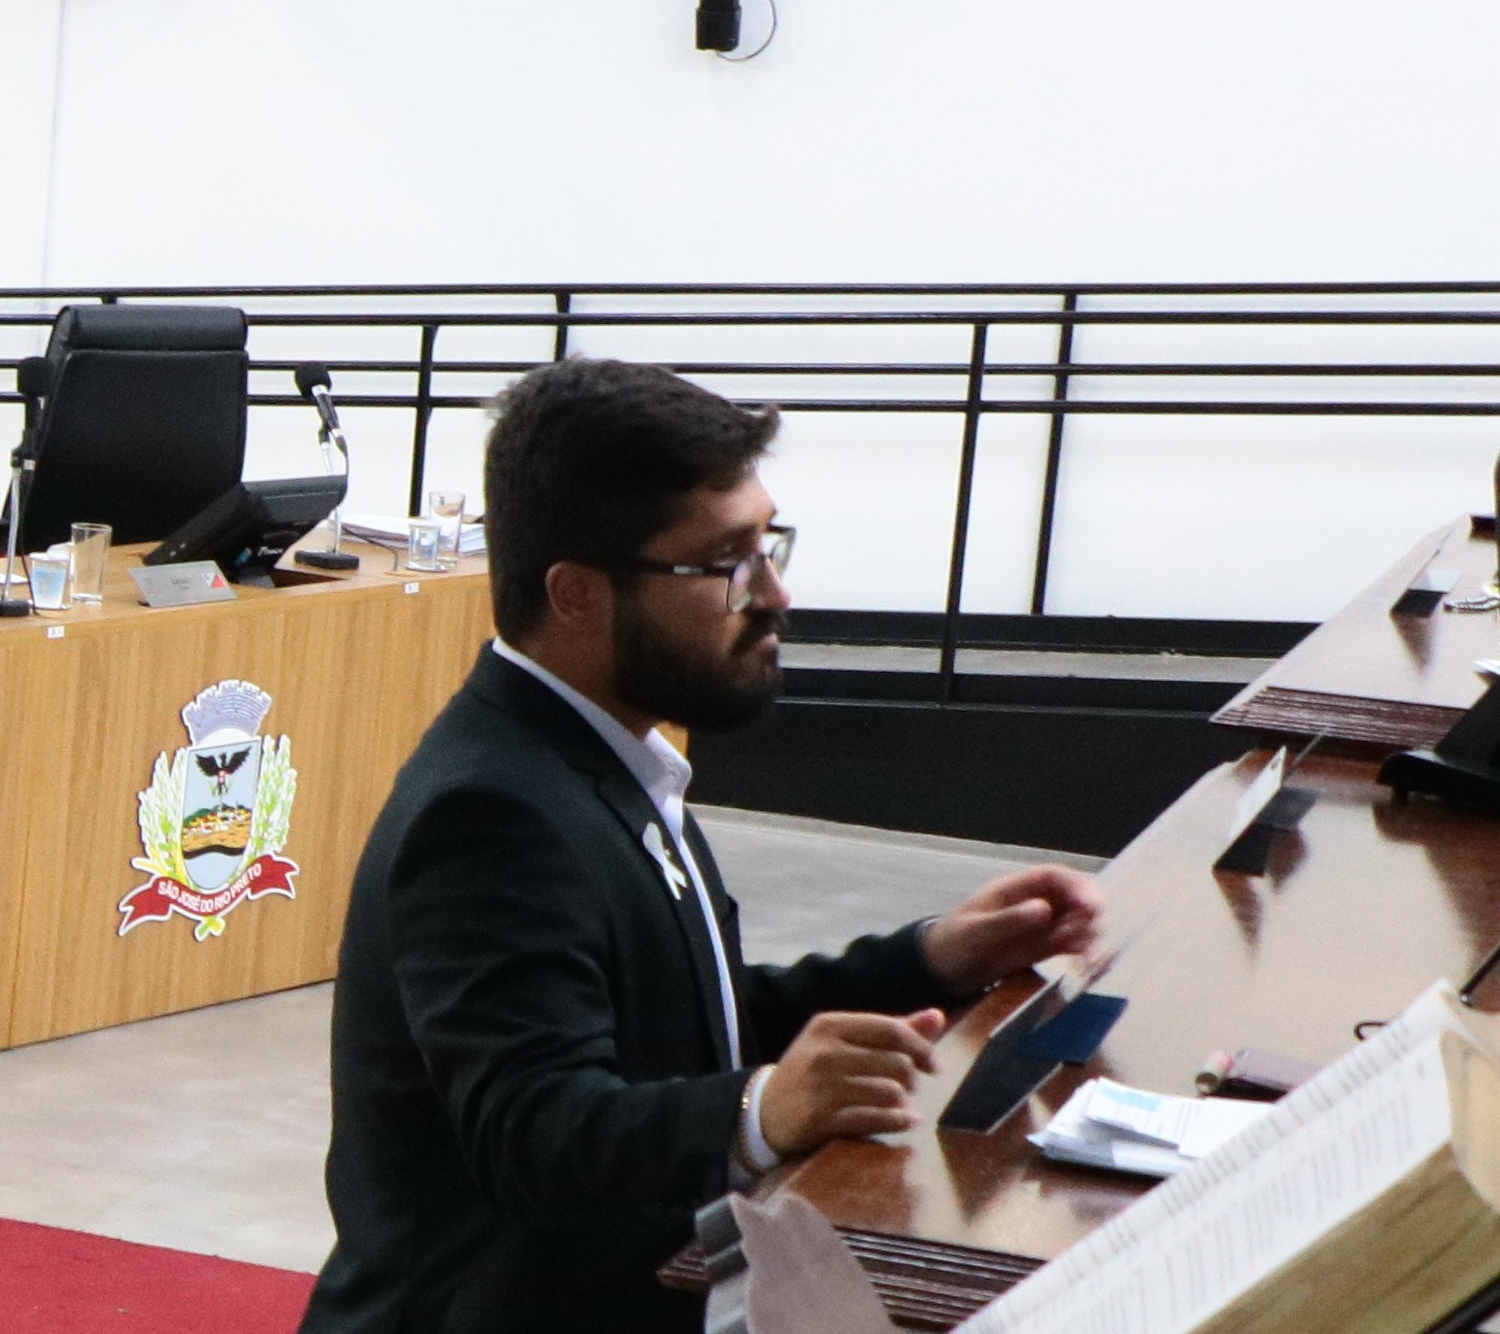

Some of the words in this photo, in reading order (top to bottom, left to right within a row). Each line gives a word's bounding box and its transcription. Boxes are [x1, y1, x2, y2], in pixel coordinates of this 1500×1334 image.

[157, 879, 180, 900] SÃO
[177, 890, 202, 913] JOSÉ
[200, 898, 214, 913] DO
[214, 891, 232, 910] RIO
[230, 862, 262, 898] PRETO
